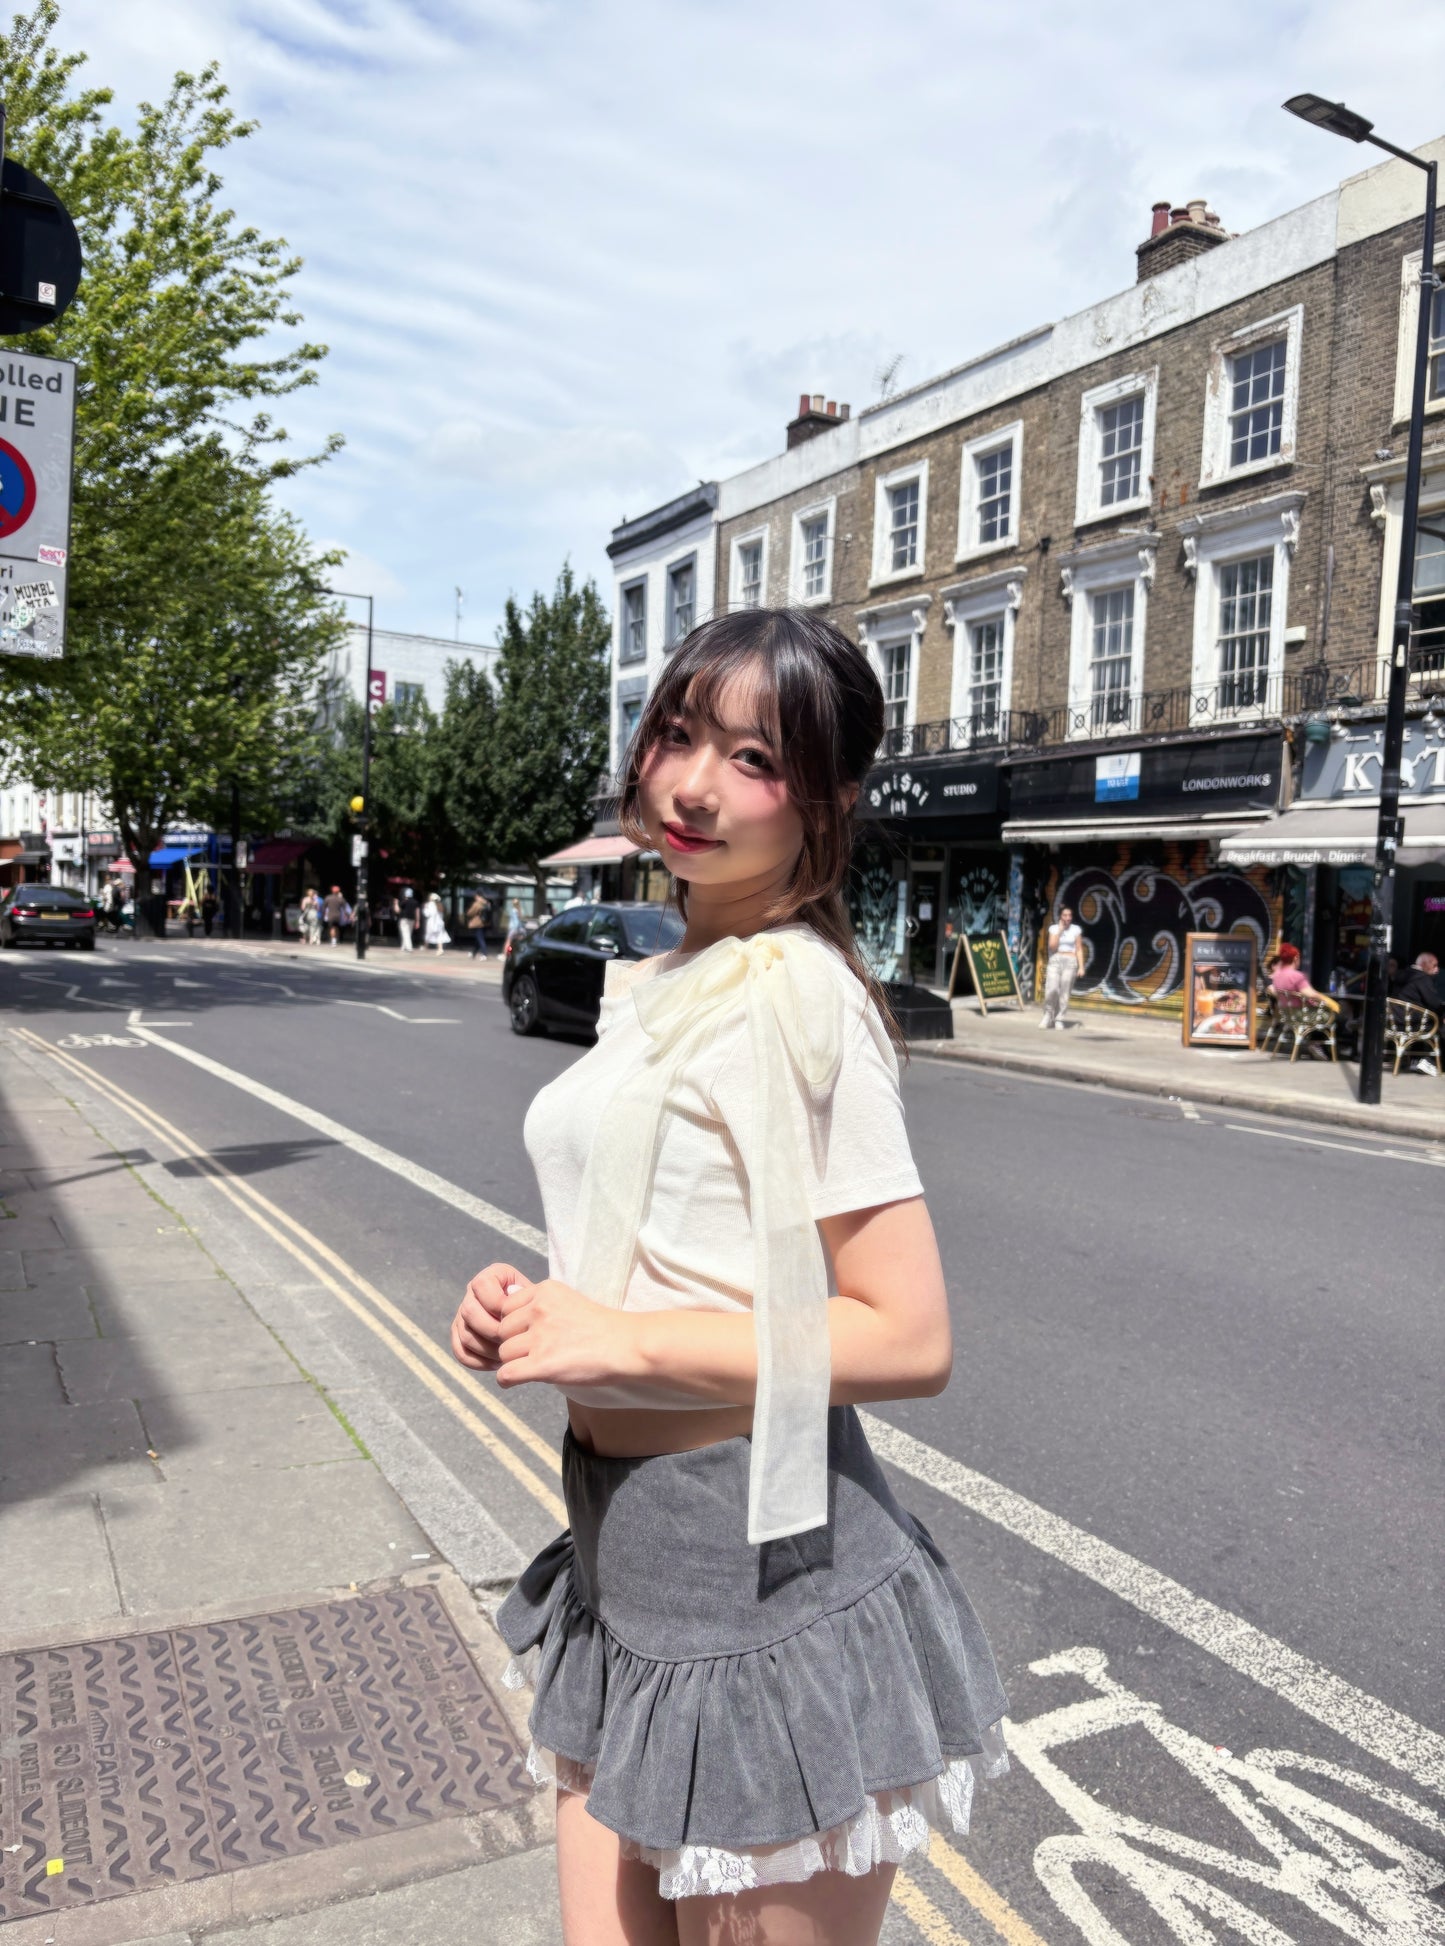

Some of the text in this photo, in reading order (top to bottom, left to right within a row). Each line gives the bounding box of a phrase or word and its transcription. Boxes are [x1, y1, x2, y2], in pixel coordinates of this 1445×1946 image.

[1372, 727, 1412, 744] TE
[943, 783, 978, 796] STUDIO
[1182, 773, 1272, 792] LONDONWORKS
[1226, 850, 1367, 862] Breakfast Brunch Dinner
[272, 1635, 315, 1700] SLIDEOUT
[53, 1744, 81, 1767] 50
[57, 1776, 93, 1866] SLIDEOUT
